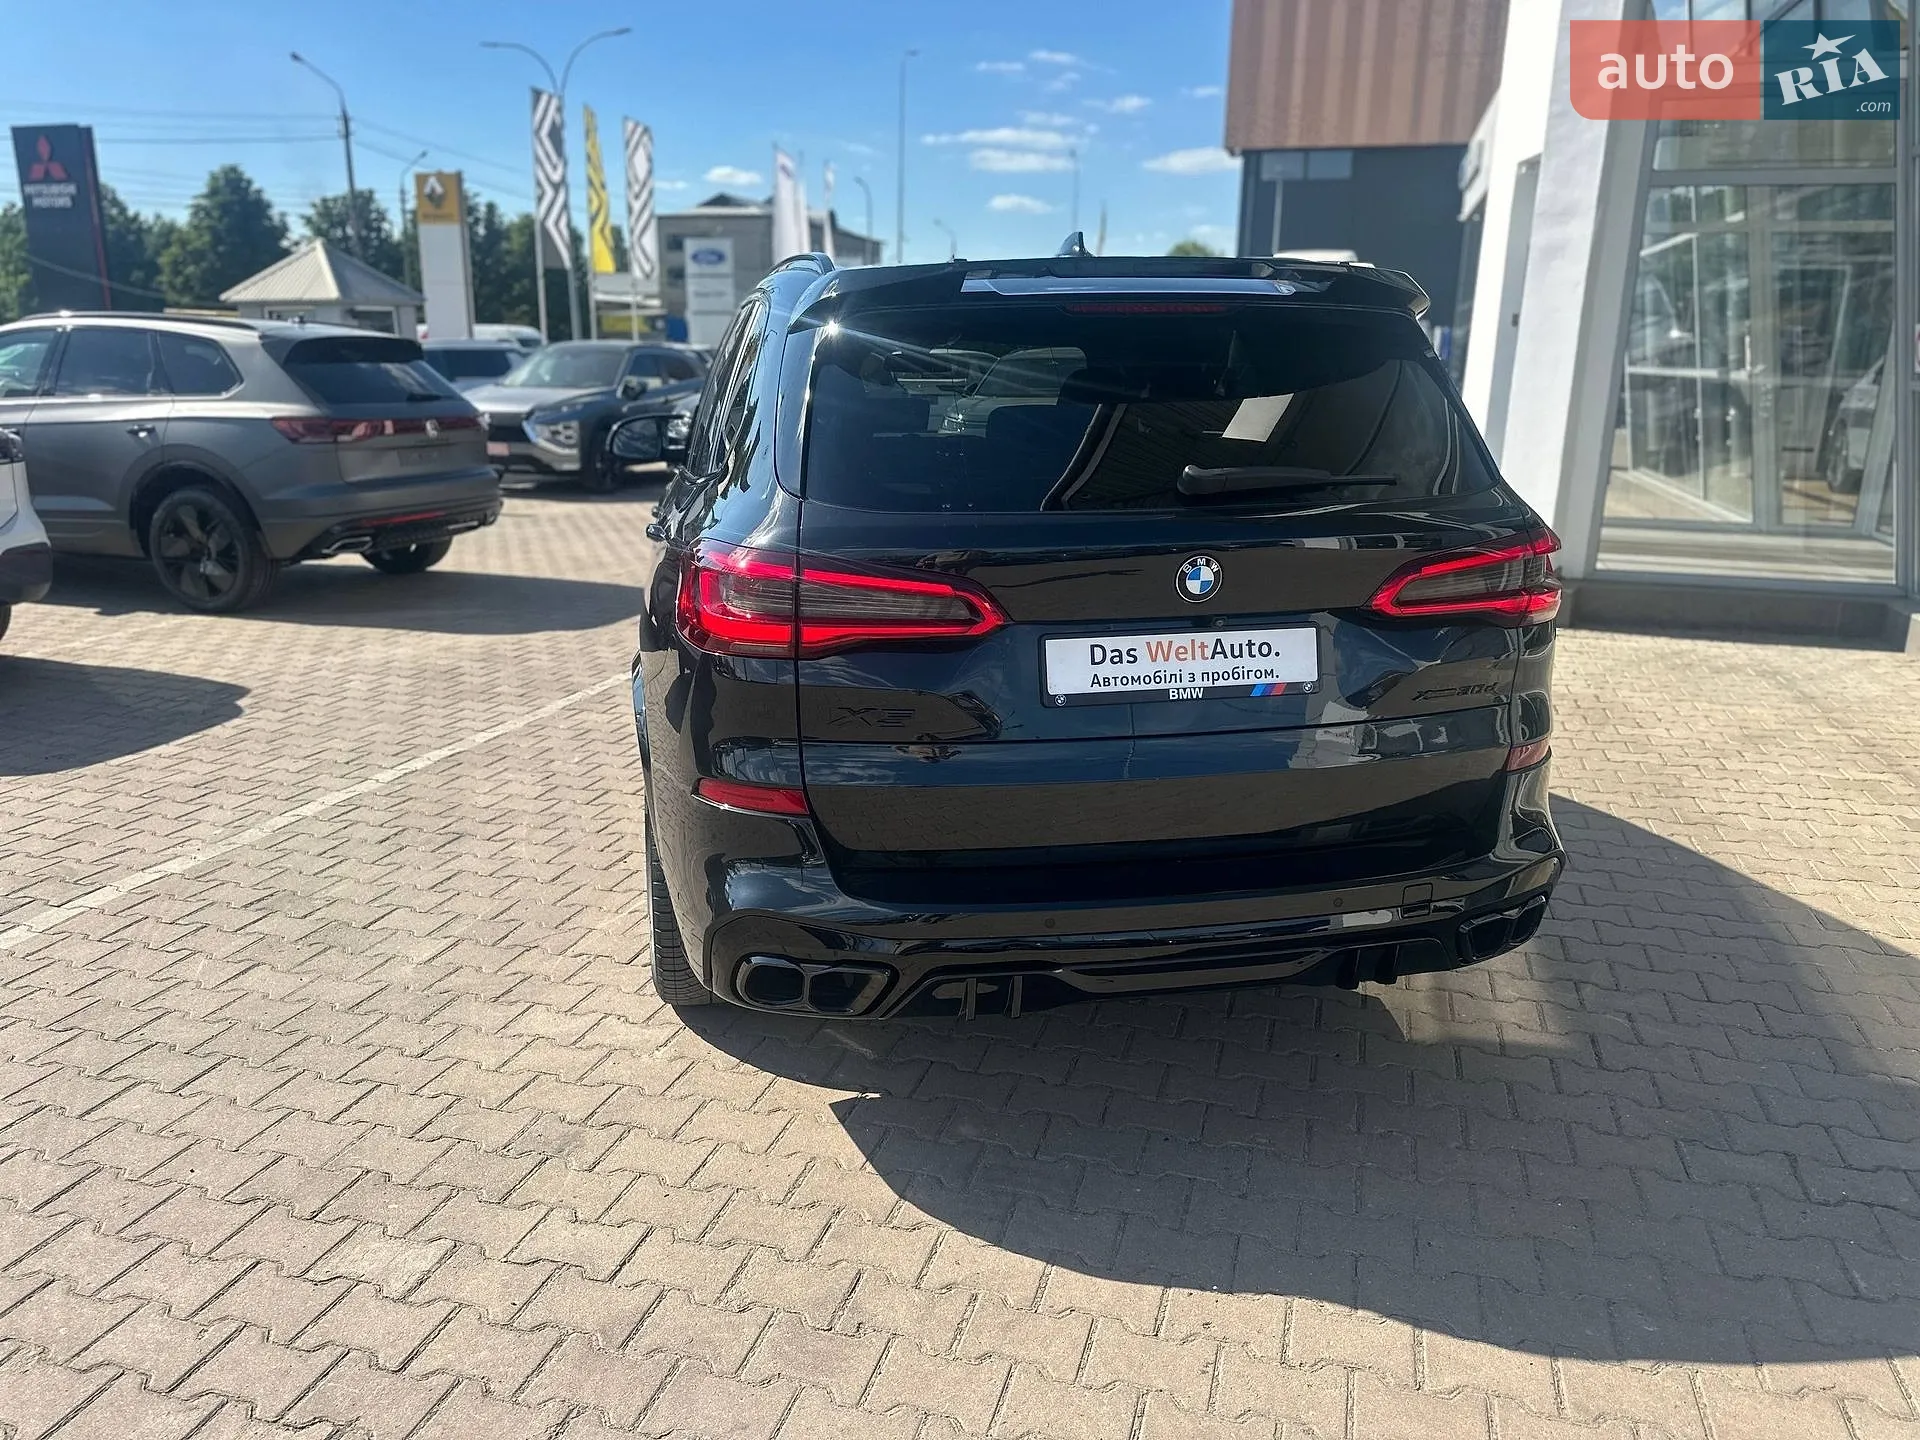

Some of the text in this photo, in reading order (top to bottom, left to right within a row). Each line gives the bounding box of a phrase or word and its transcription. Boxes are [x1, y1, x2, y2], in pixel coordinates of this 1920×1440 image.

[1182, 557, 1220, 574] BMW
[1089, 637, 1281, 666] Das WeltAuto.
[1090, 666, 1280, 688] Автомобілі з пробігом.
[1168, 687, 1204, 701] BMW
